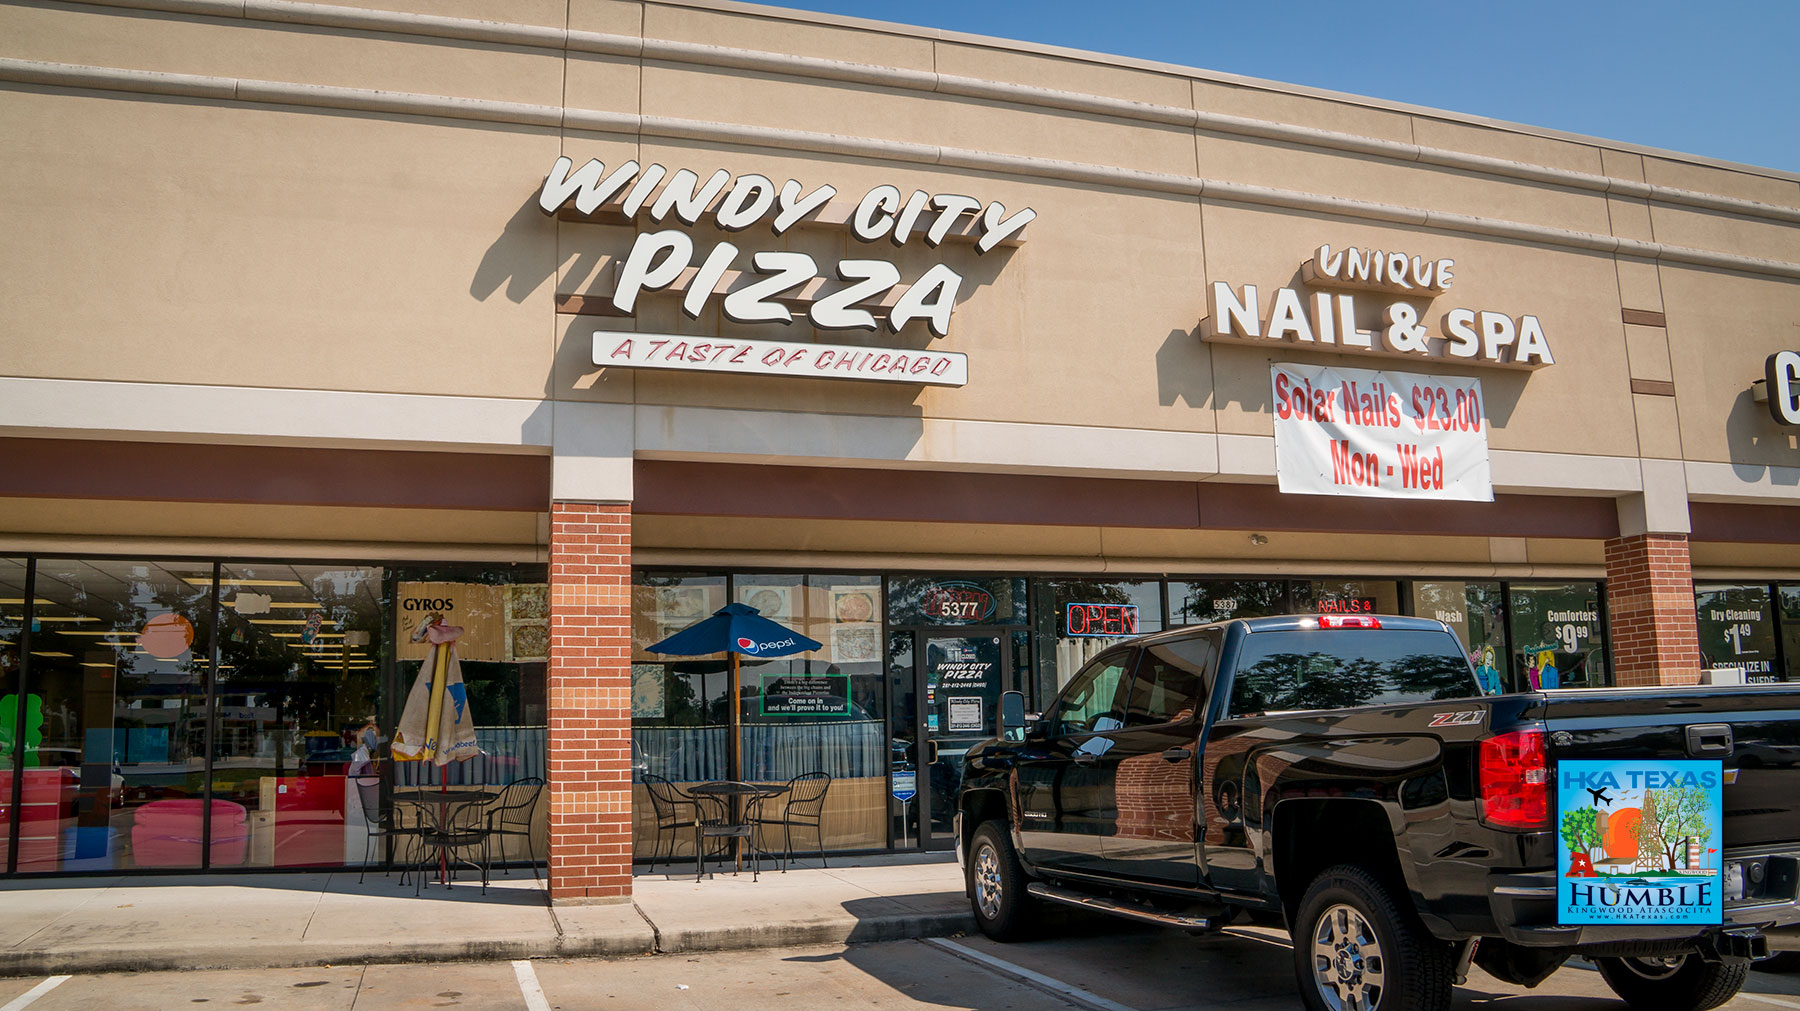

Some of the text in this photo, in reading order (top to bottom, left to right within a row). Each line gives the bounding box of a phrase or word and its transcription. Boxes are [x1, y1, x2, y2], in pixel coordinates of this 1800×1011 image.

[539, 156, 1037, 255] WINDY CITY
[1313, 243, 1455, 291] UNIQUE
[612, 229, 964, 338] PIZZA
[1210, 281, 1554, 365] NAIL & SPA
[610, 338, 952, 377] A TASTE OF CHICAGO
[1275, 373, 1482, 435] Solar Nails $23.00
[1330, 439, 1379, 486] Mon
[1396, 443, 1444, 490] Wed
[403, 598, 454, 611] GYROS
[942, 602, 978, 616] 5377
[1214, 601, 1237, 609] 5387
[1318, 600, 1371, 613] NAILS &
[1069, 605, 1137, 634] OPEN
[1435, 610, 1463, 623] Wash
[1547, 610, 1597, 622] Comforters
[1710, 609, 1761, 621] Dry Cleaning
[759, 637, 796, 651] pepsi
[1761, 661, 1770, 672] IN
[944, 671, 983, 679] PIZZA
[1428, 710, 1487, 727] Z71
